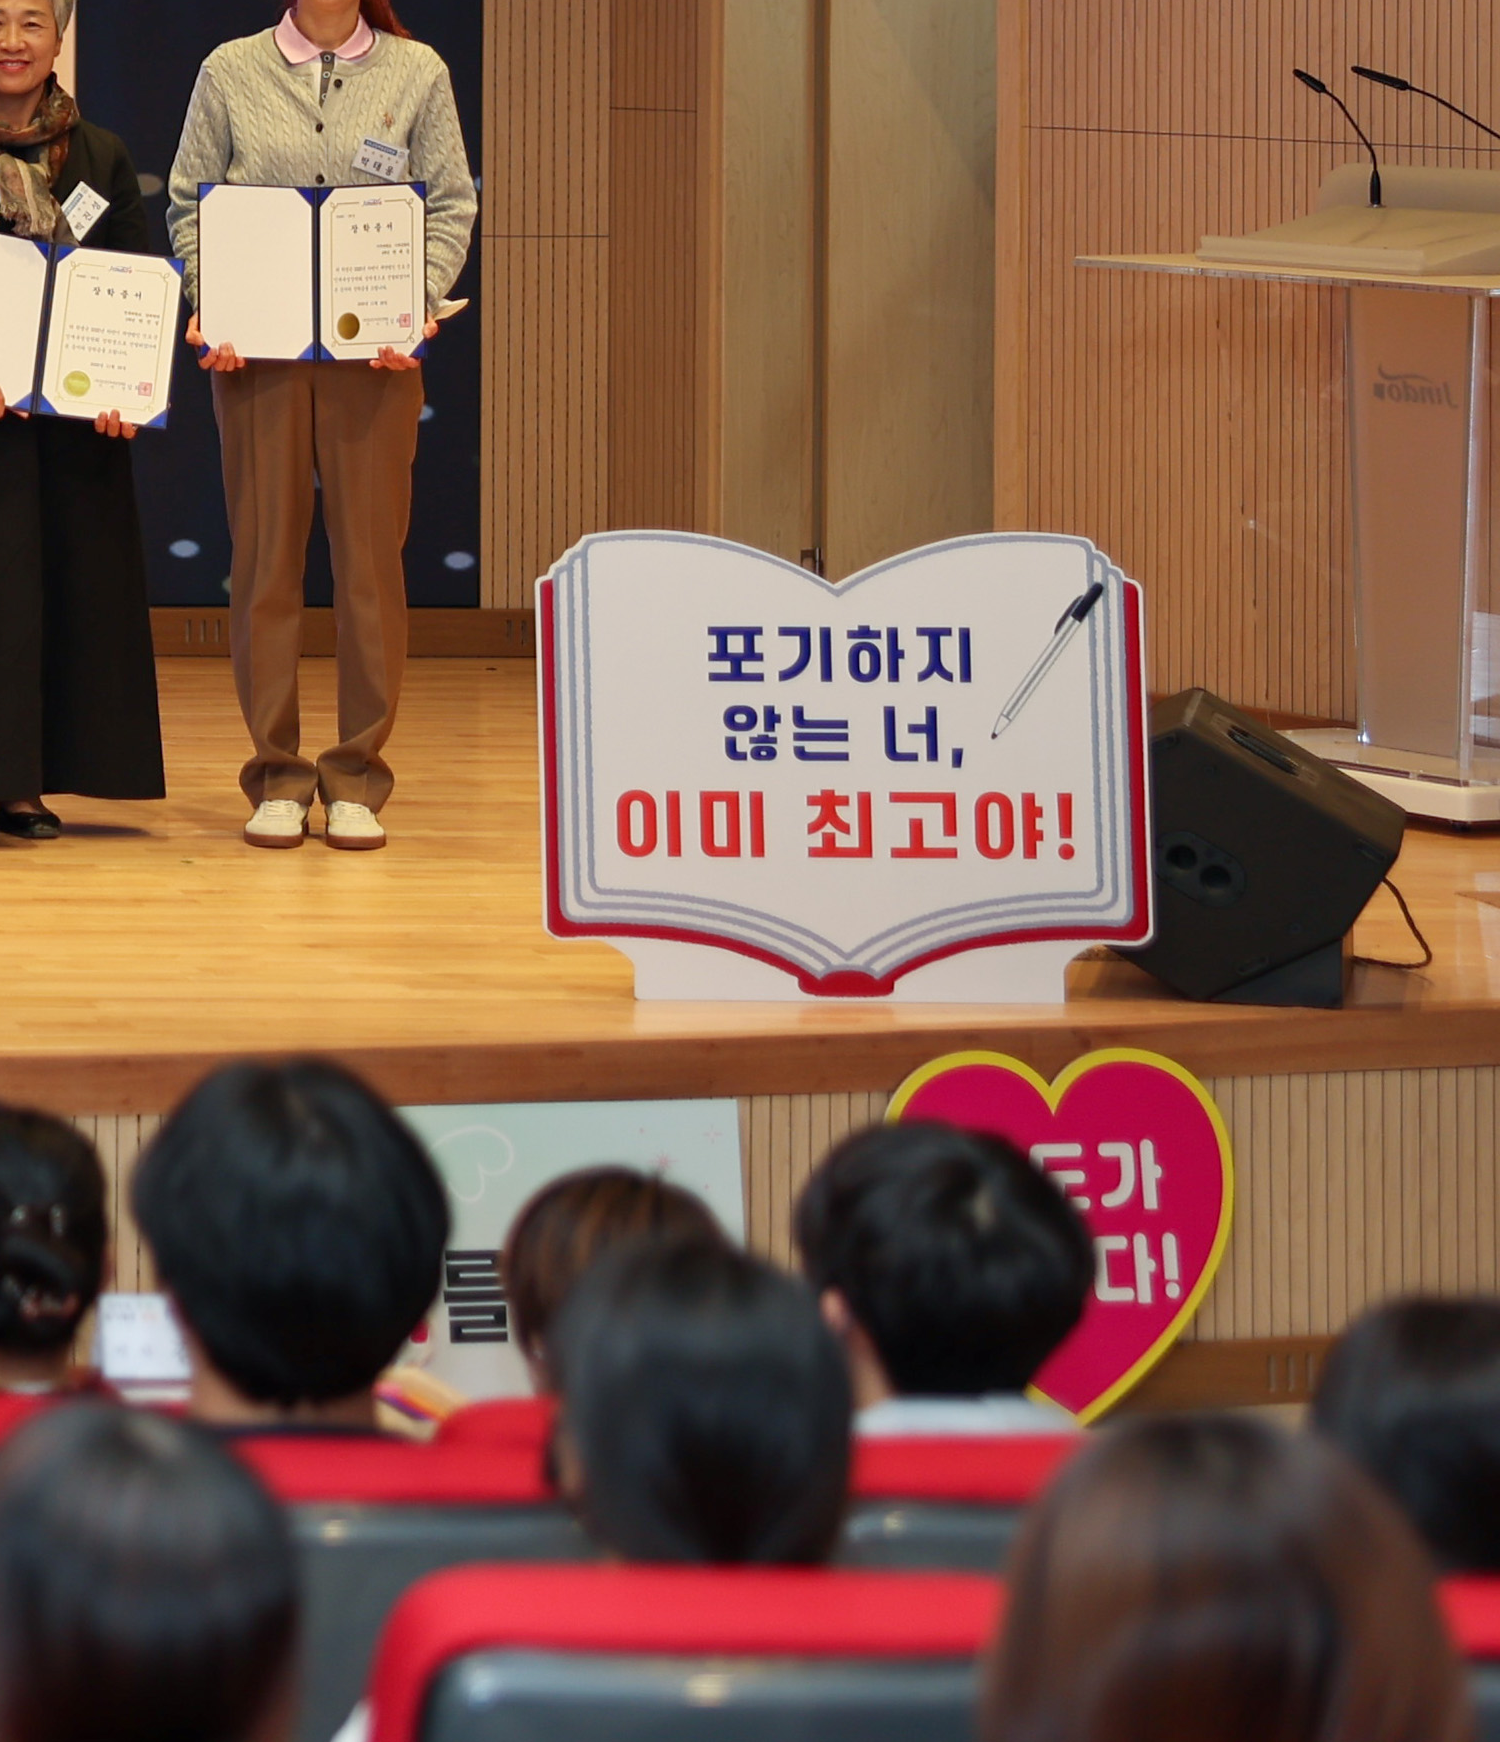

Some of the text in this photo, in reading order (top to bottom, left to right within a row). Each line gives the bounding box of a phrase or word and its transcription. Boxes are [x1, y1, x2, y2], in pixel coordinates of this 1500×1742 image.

[707, 625, 972, 684] 포기하지
[722, 705, 964, 769] 않는 너,
[615, 788, 1076, 861] 이미 최고야!
[1029, 1138, 1163, 1210] 도가
[1093, 1231, 1181, 1304] 다!
